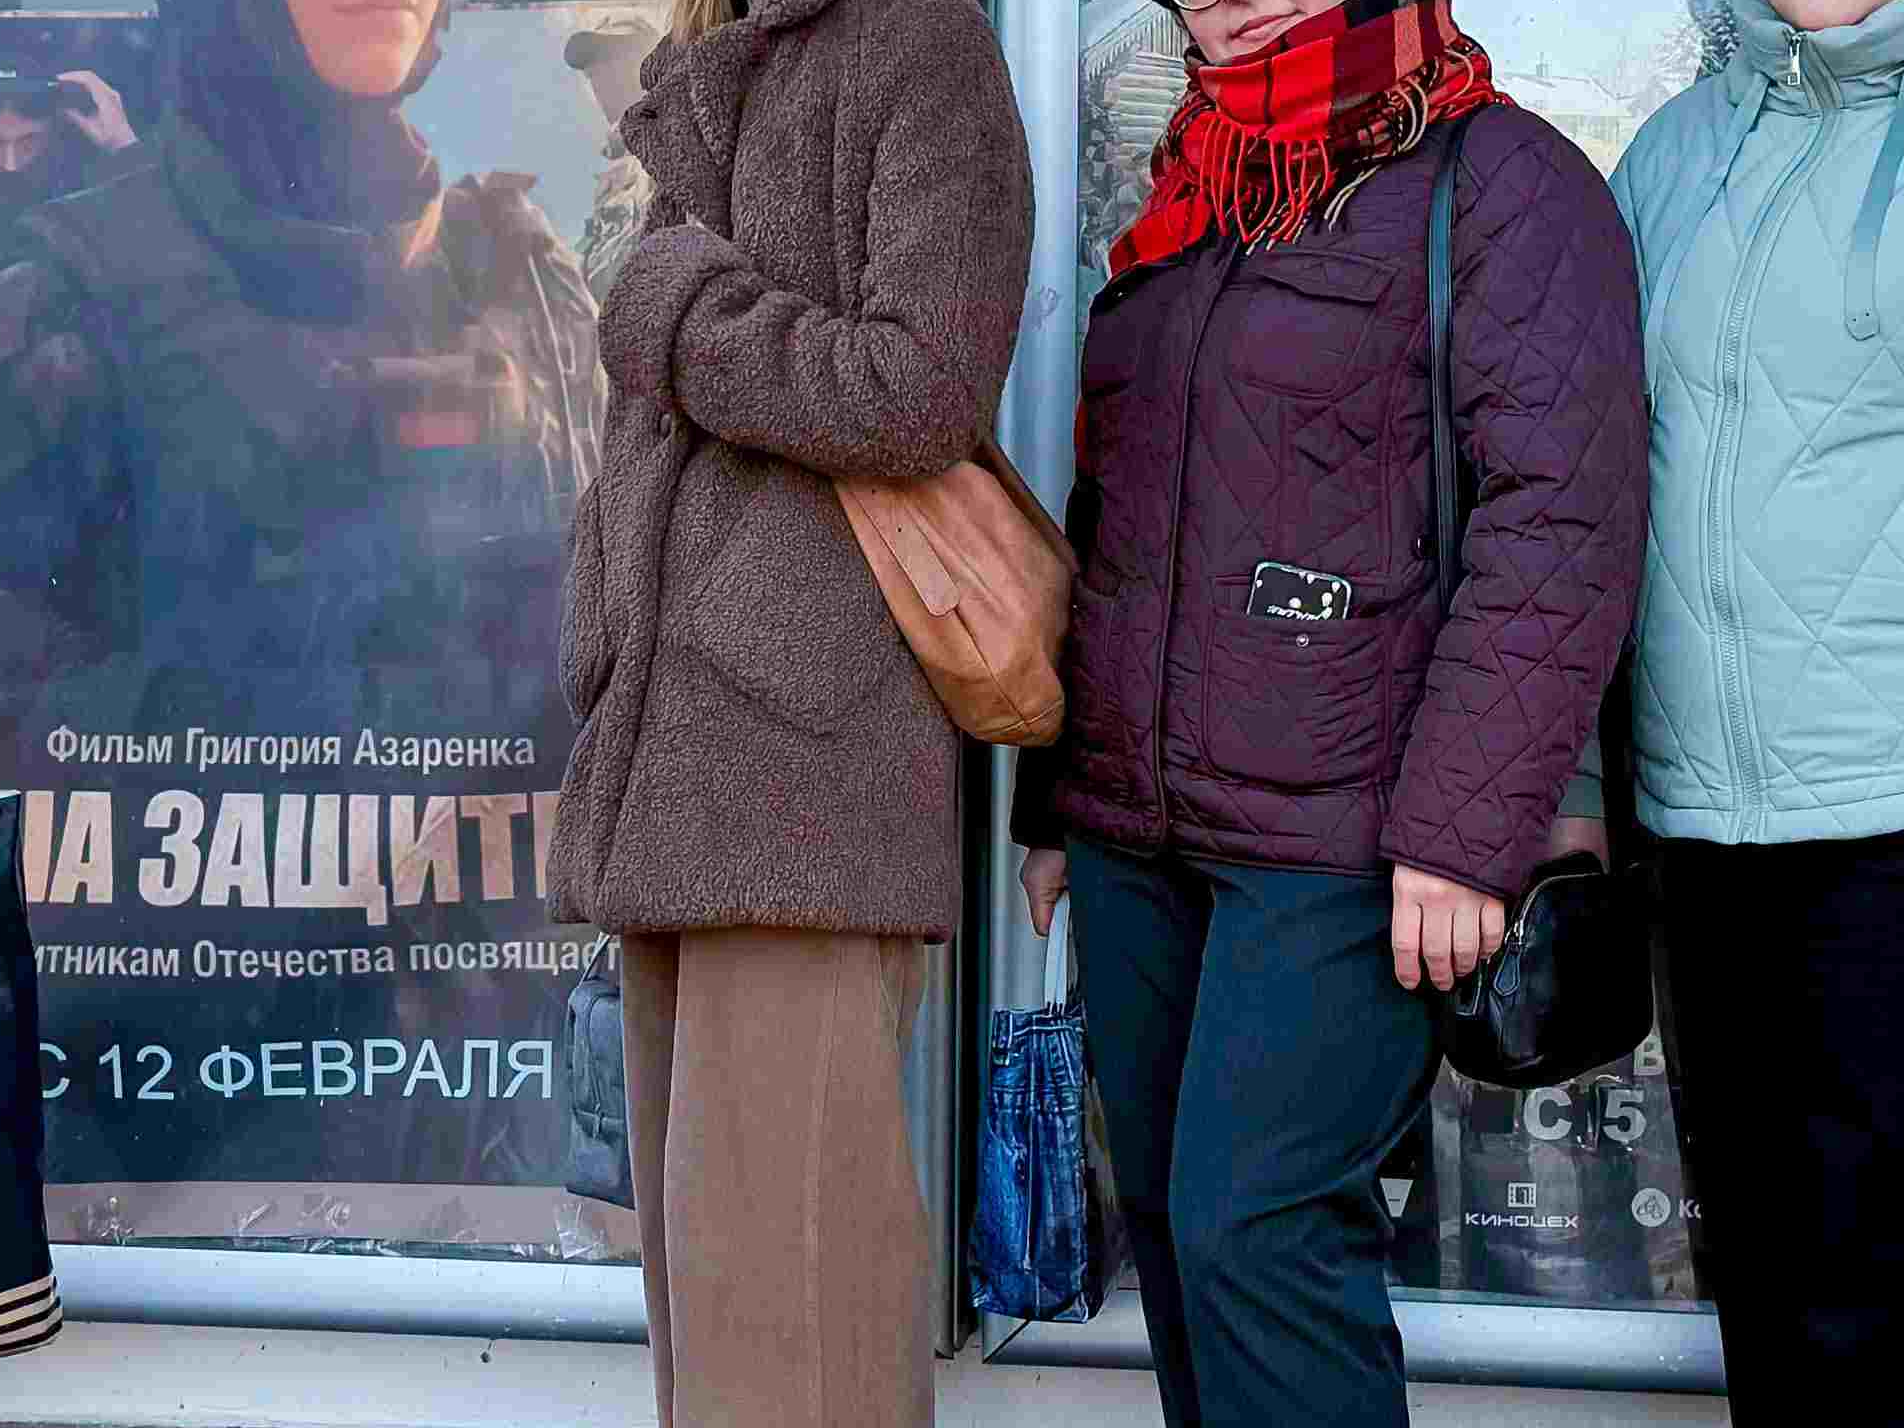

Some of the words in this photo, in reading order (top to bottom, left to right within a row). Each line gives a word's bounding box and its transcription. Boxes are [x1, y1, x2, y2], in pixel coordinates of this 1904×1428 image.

[47, 725, 172, 764] Фильм
[184, 727, 342, 772] Григория
[353, 729, 536, 775] Азаренка
[193, 940, 394, 978] Отечества
[98, 1044, 175, 1100] 12
[199, 1039, 553, 1100] ФЕВРАЛЯ
[1602, 1089, 1647, 1142] 5
[1465, 1213, 1579, 1229] КИНОЦЕХ
